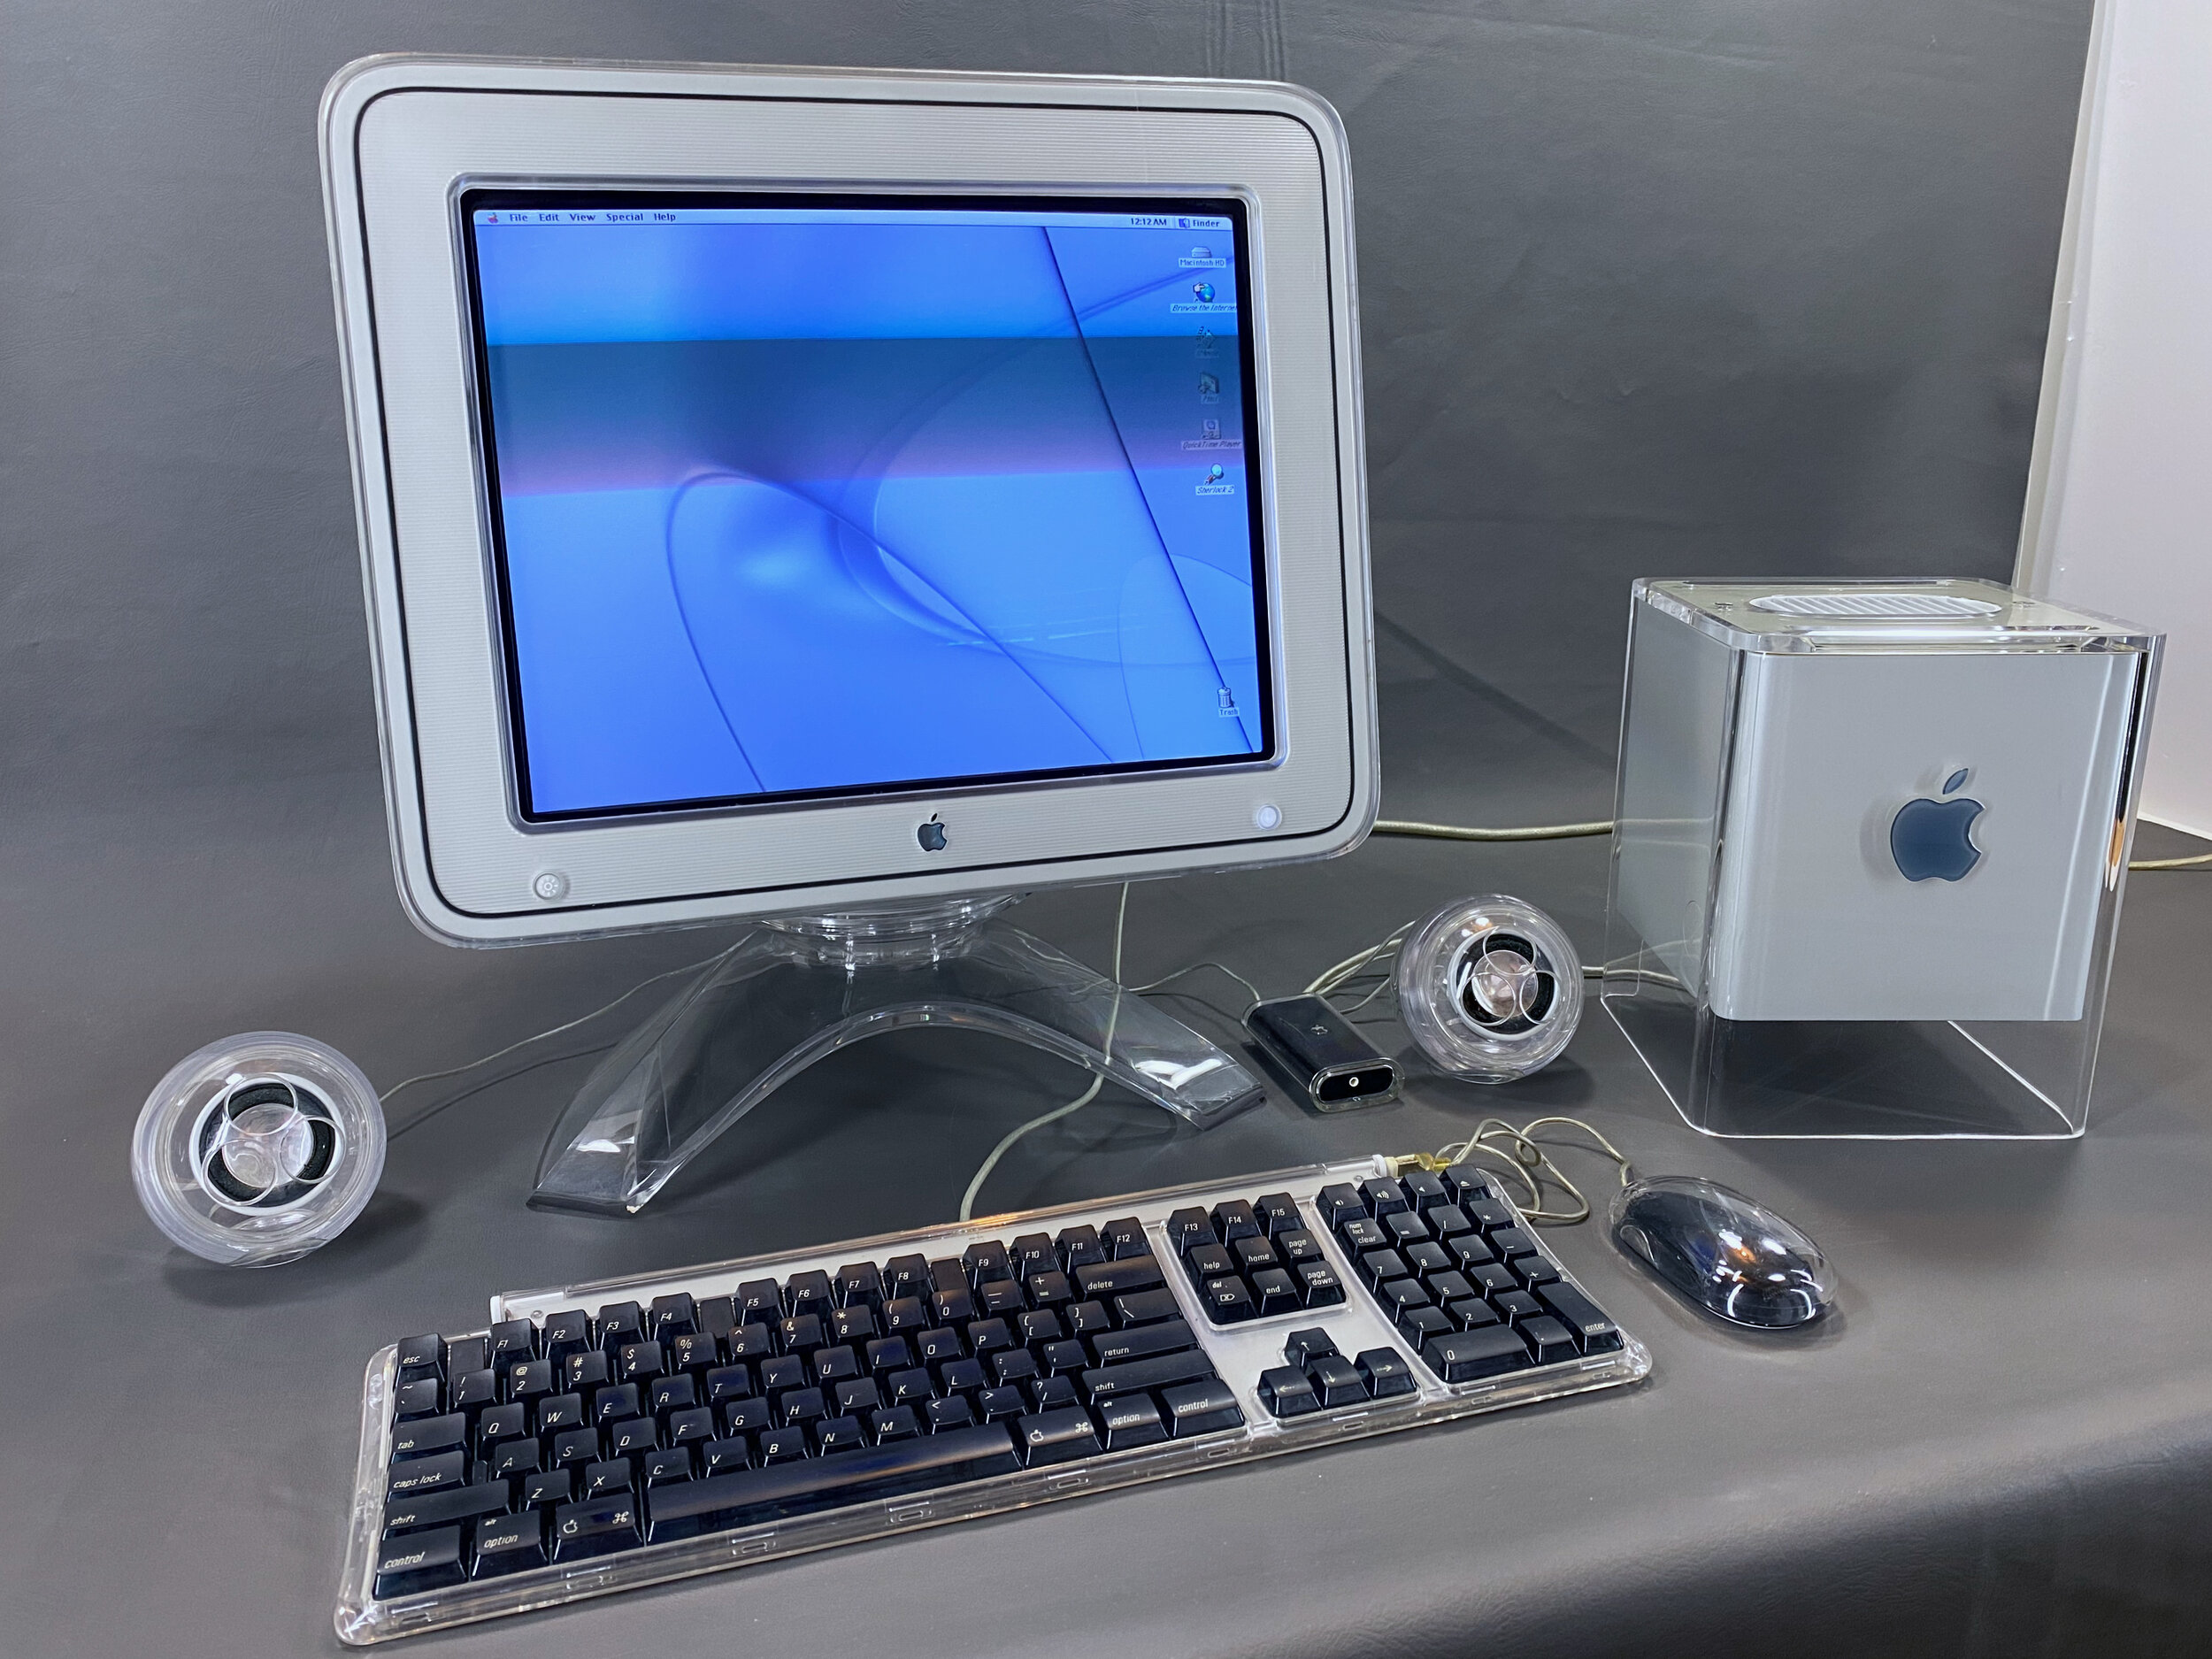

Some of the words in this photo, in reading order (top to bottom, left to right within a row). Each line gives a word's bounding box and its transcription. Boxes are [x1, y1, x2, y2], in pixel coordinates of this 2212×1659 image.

[510, 213, 528, 222] File
[539, 213, 559, 222] Edit
[570, 213, 596, 222] View
[606, 212, 643, 223] Special
[654, 212, 676, 223] Help
[1118, 1234, 1130, 1243] F12
[1289, 1240, 1307, 1248] page
[1308, 1271, 1326, 1279] page
[1088, 1281, 1112, 1290] delete
[1312, 1278, 1333, 1286] down
[747, 1298, 758, 1307] F5
[943, 1307, 949, 1316] 0
[893, 1316, 899, 1325] 9
[787, 1322, 794, 1331] &
[1586, 1323, 1606, 1333] enter
[552, 1330, 565, 1339] F2
[789, 1334, 796, 1343] 7
[497, 1340, 508, 1348] F1
[680, 1339, 692, 1348] %
[979, 1336, 986, 1345] P
[737, 1343, 744, 1352] 6
[927, 1345, 935, 1355] O
[1105, 1348, 1129, 1356] return
[627, 1348, 634, 1359] $
[683, 1353, 690, 1362] 5
[1448, 1350, 1455, 1360] 0
[573, 1357, 583, 1367] #
[628, 1362, 635, 1371] 4
[823, 1364, 831, 1374] U
[573, 1371, 581, 1380] 3
[770, 1373, 777, 1383] Y
[951, 1376, 957, 1385] L
[517, 1381, 525, 1390] 2
[715, 1384, 722, 1394] T
[899, 1386, 906, 1394] K
[1095, 1382, 1114, 1391] shift
[458, 1391, 465, 1400] 1
[660, 1393, 669, 1402] R
[844, 1395, 852, 1405] J
[603, 1403, 611, 1413] E
[790, 1406, 799, 1415] H
[1179, 1400, 1208, 1413] control
[548, 1412, 562, 1423] W
[735, 1416, 744, 1425] G
[1112, 1414, 1141, 1426] option
[488, 1423, 499, 1433] Q
[679, 1425, 687, 1435] F
[881, 1422, 893, 1432] M
[620, 1436, 630, 1446] D
[826, 1433, 834, 1442] N
[398, 1440, 414, 1449] tab
[770, 1444, 778, 1453] B
[563, 1447, 573, 1456] S
[503, 1457, 512, 1467] A
[712, 1455, 720, 1463] V
[654, 1465, 663, 1474] C
[394, 1479, 418, 1488] caps
[419, 1473, 441, 1484] lock
[594, 1477, 604, 1486] X
[532, 1488, 542, 1498] Z
[390, 1515, 415, 1525] shift
[484, 1535, 518, 1548] option
[384, 1552, 426, 1570] control
